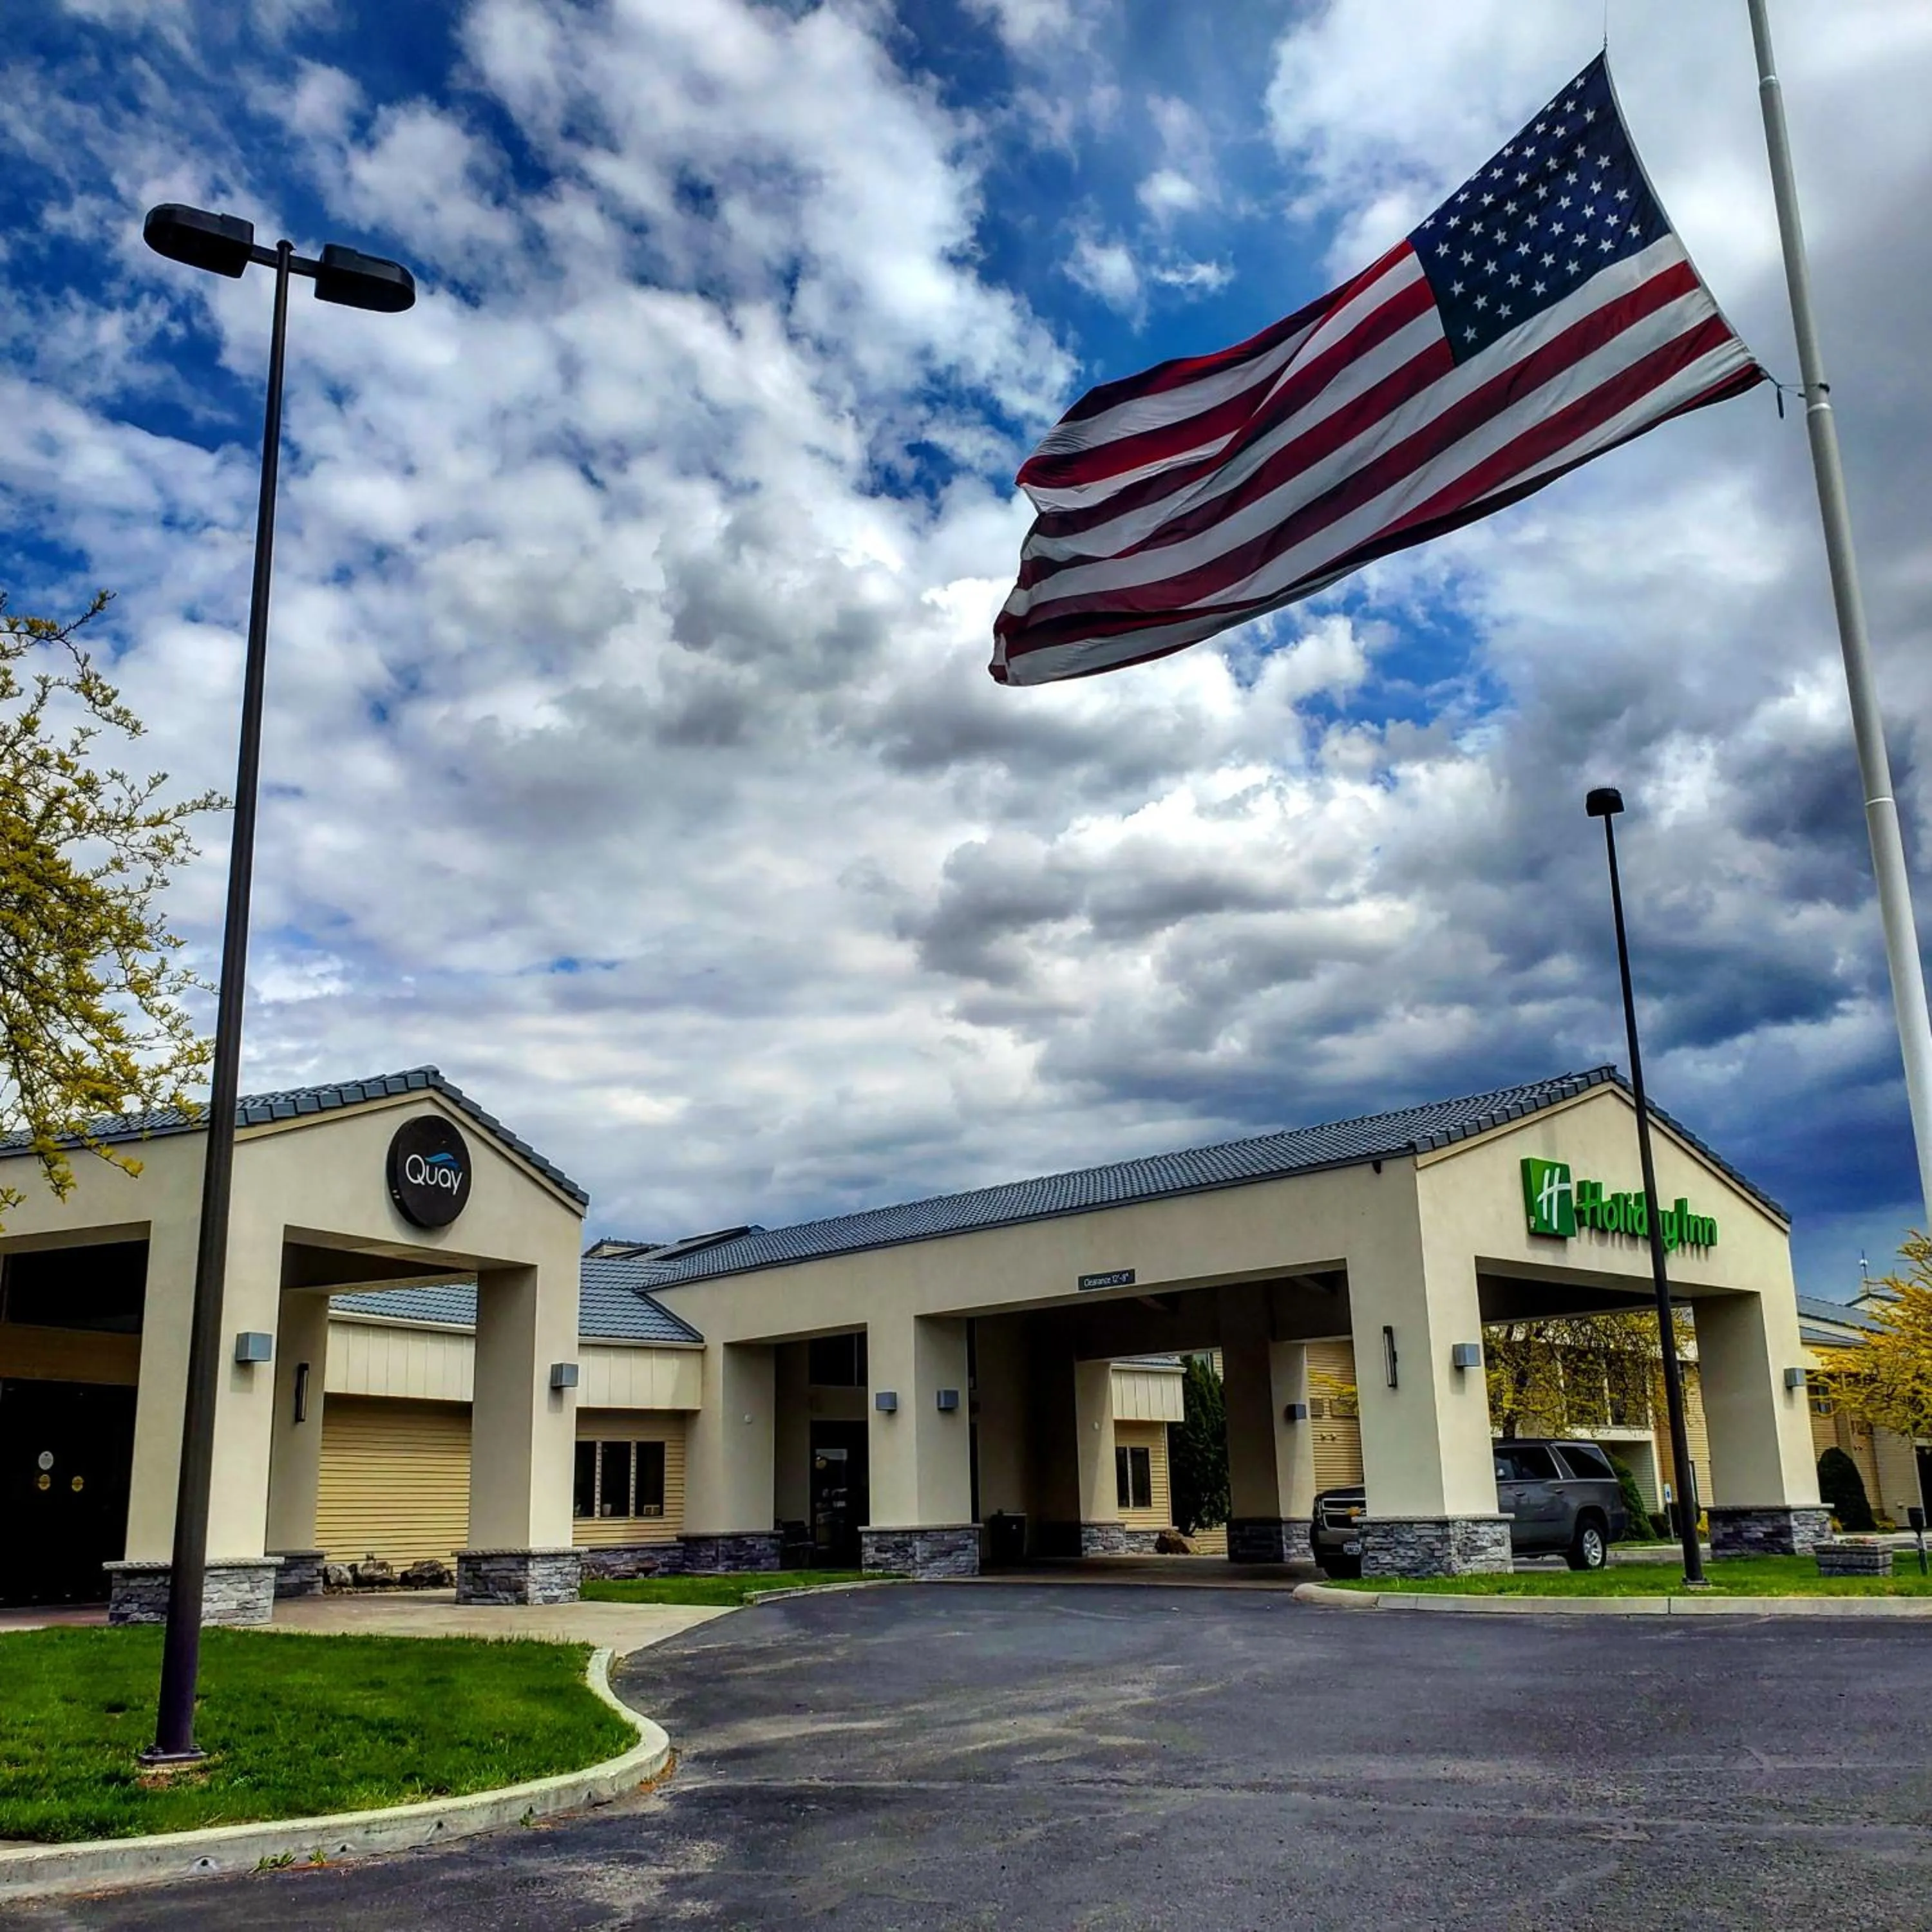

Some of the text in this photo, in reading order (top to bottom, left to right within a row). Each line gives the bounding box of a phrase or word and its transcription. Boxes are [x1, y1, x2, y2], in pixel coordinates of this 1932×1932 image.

[405, 1153, 463, 1196] Quay
[1575, 1180, 1718, 1251] Holidy Inn
[1084, 1277, 1111, 1287] Clearance
